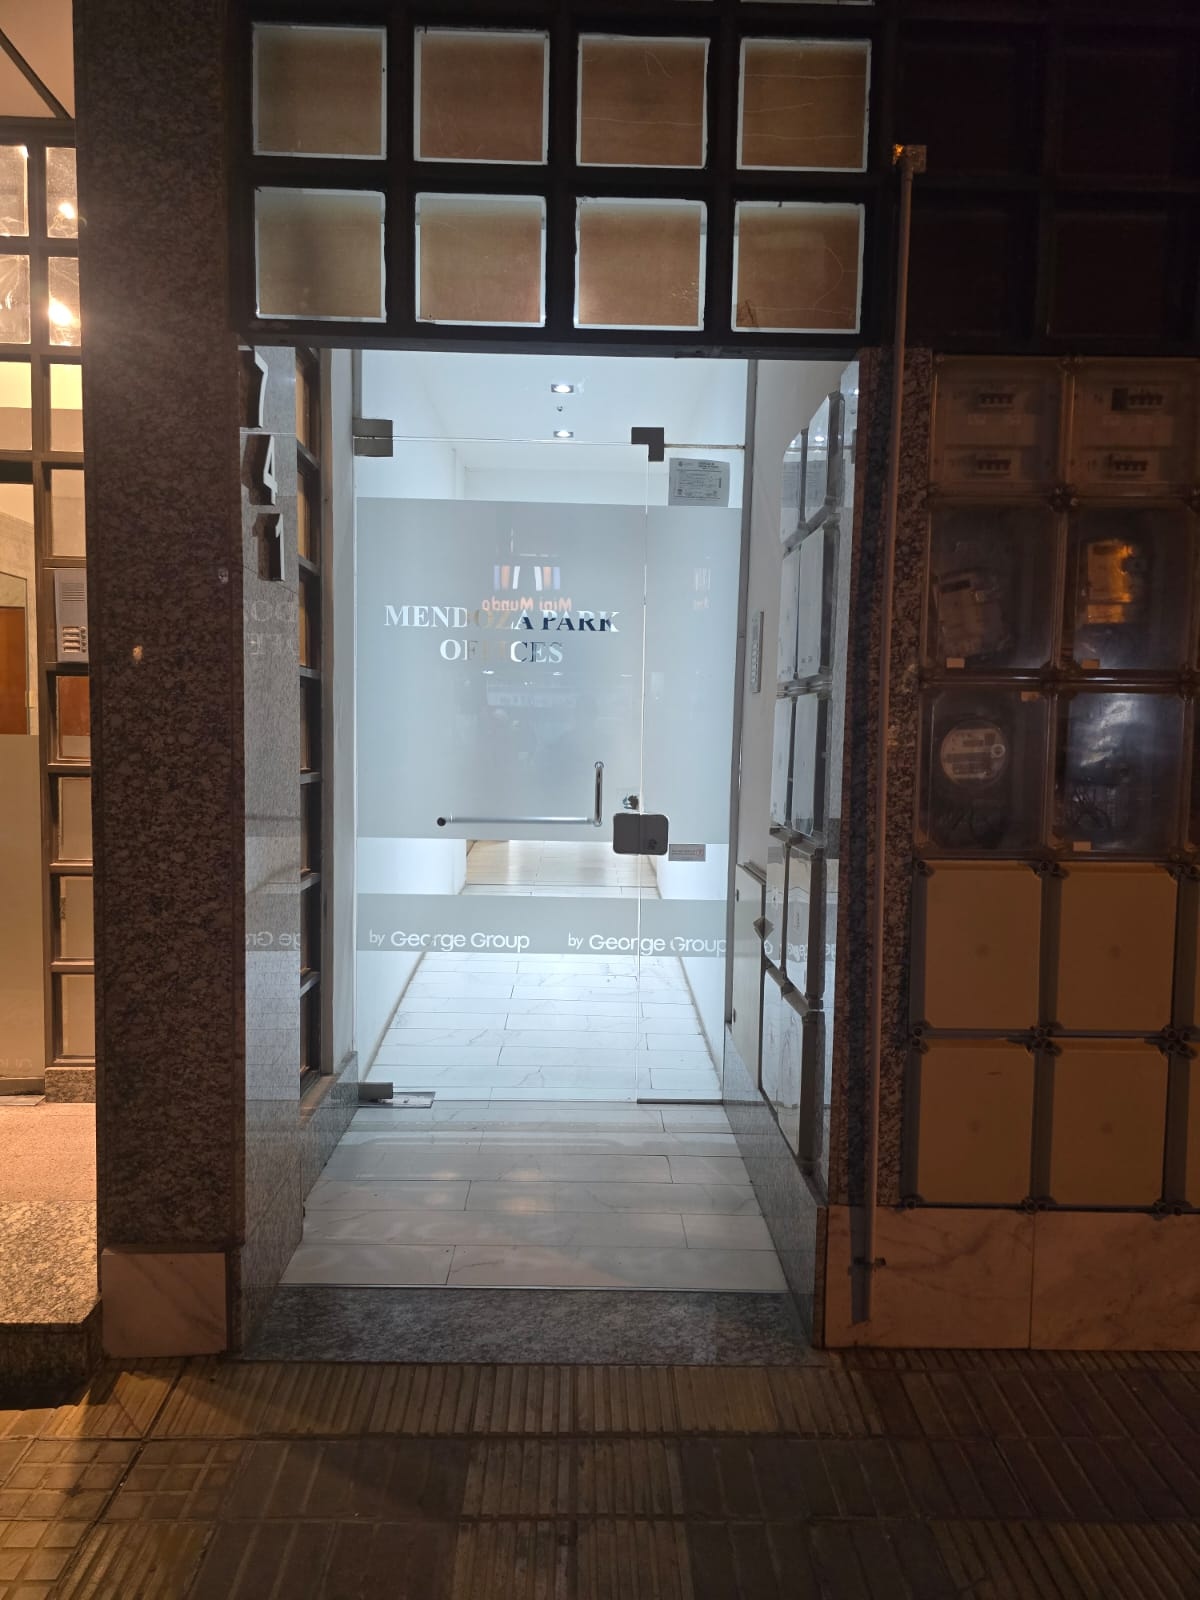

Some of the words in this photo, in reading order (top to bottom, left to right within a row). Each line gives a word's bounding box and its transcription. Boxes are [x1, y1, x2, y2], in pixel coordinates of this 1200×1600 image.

[384, 605, 534, 630] MENDOZA
[542, 609, 620, 632] PARK
[439, 639, 563, 663] OFCES
[369, 928, 386, 947] by
[390, 930, 466, 952] George
[470, 932, 530, 953] Group
[567, 931, 584, 950] by
[589, 934, 666, 956] George
[670, 936, 726, 957] Group
